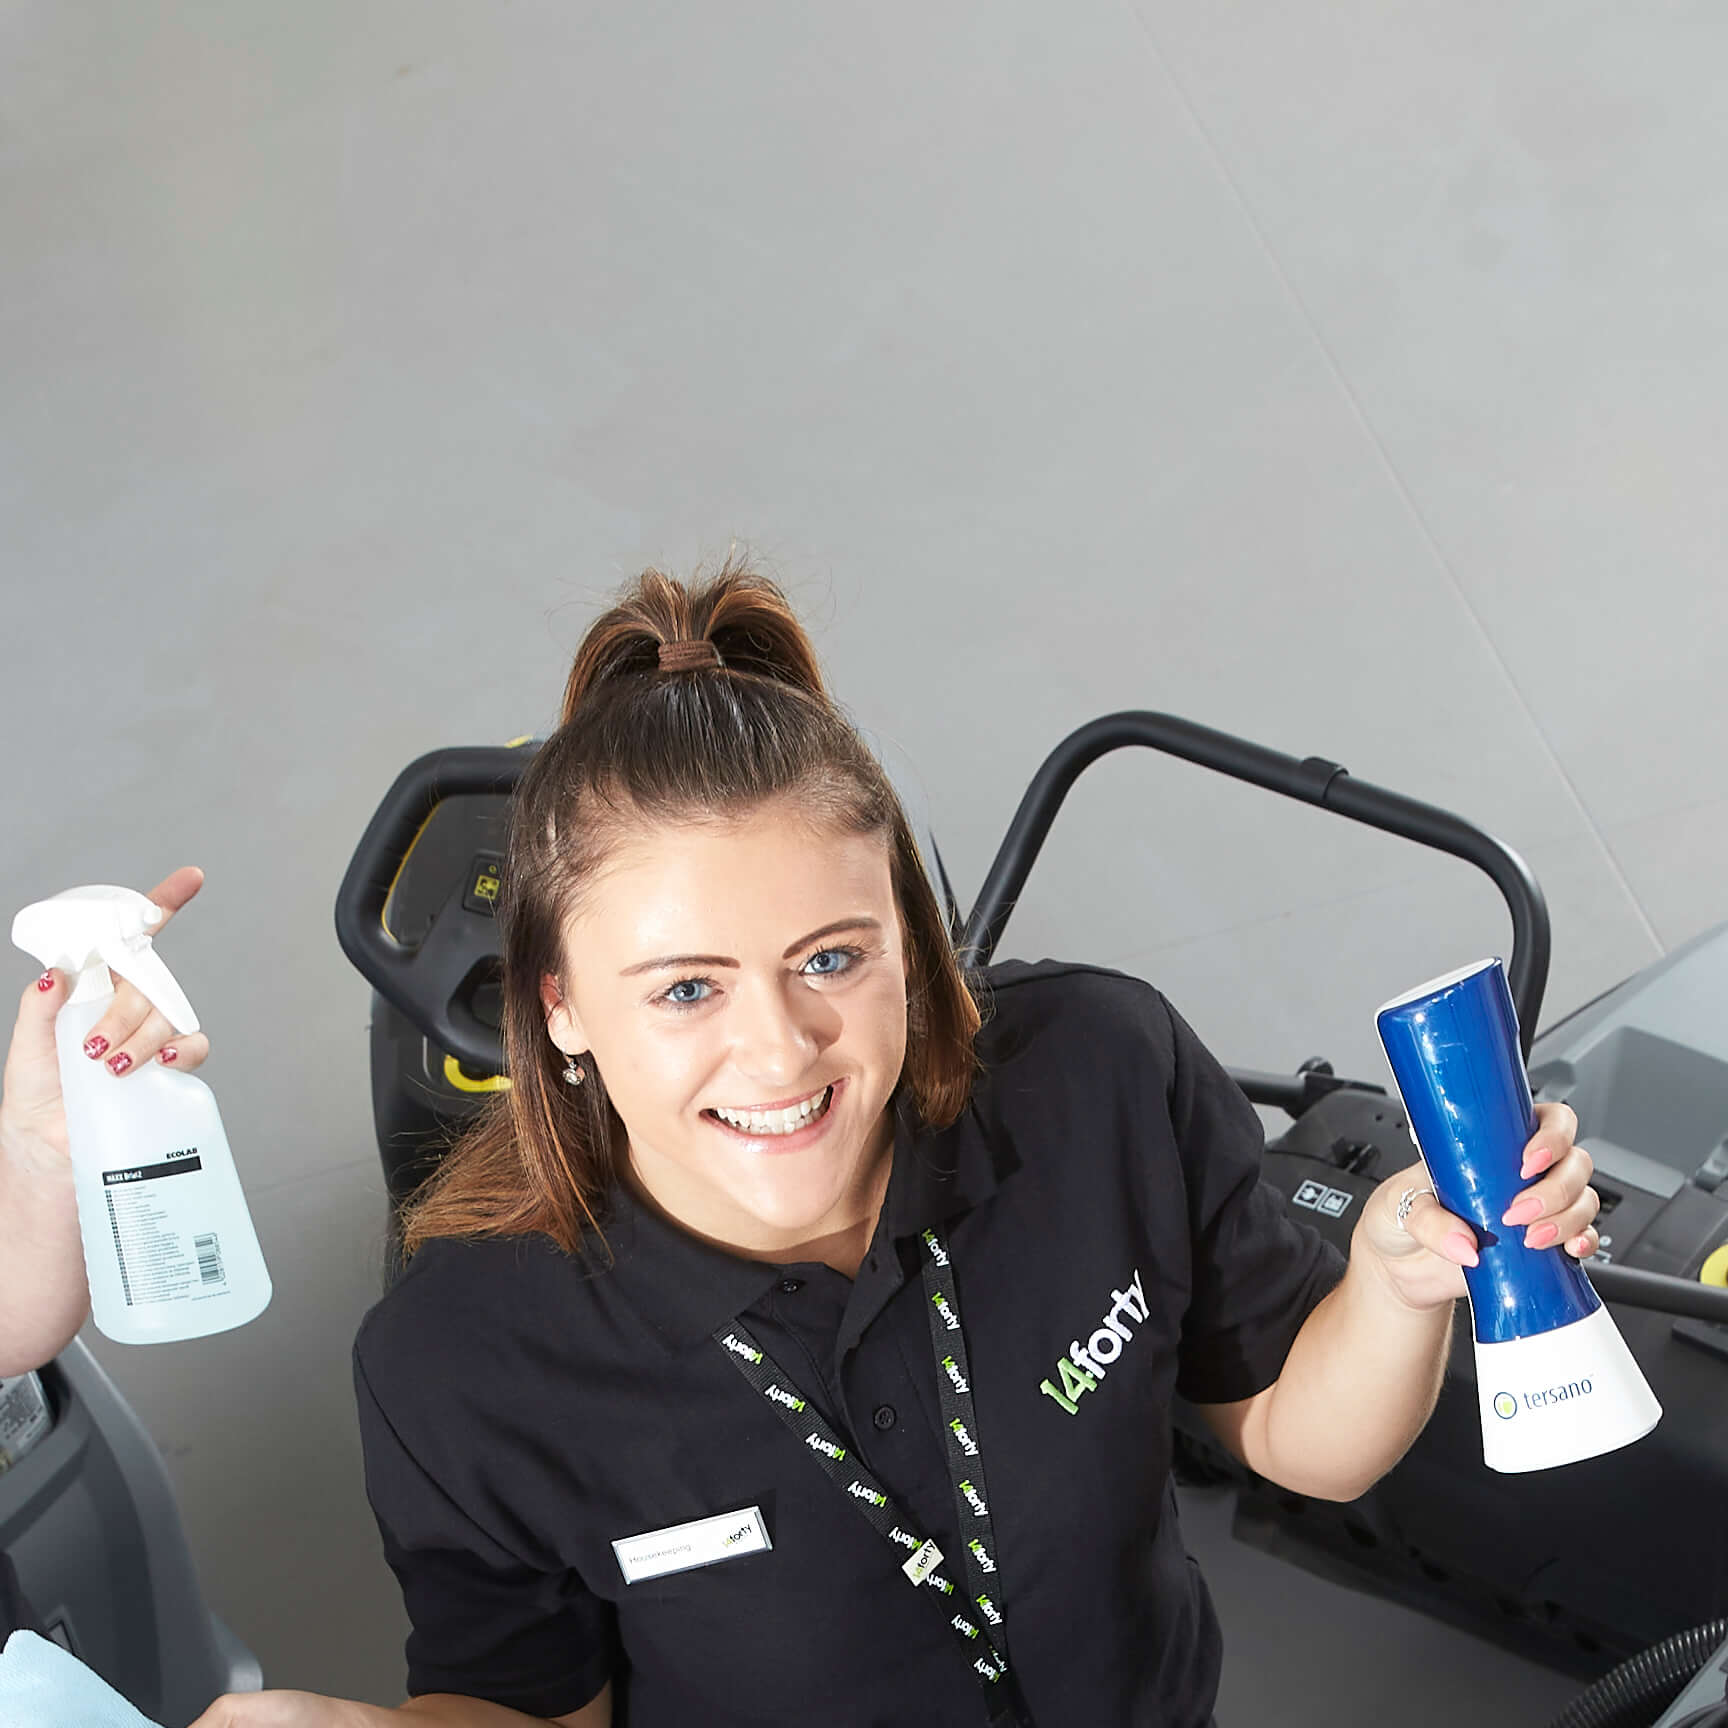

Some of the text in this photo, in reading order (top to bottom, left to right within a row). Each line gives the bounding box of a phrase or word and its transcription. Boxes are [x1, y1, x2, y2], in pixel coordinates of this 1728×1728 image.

[166, 1147, 198, 1159] ECOLAB
[1040, 1269, 1149, 1415] 14forty
[1523, 1379, 1592, 1410] tersano
